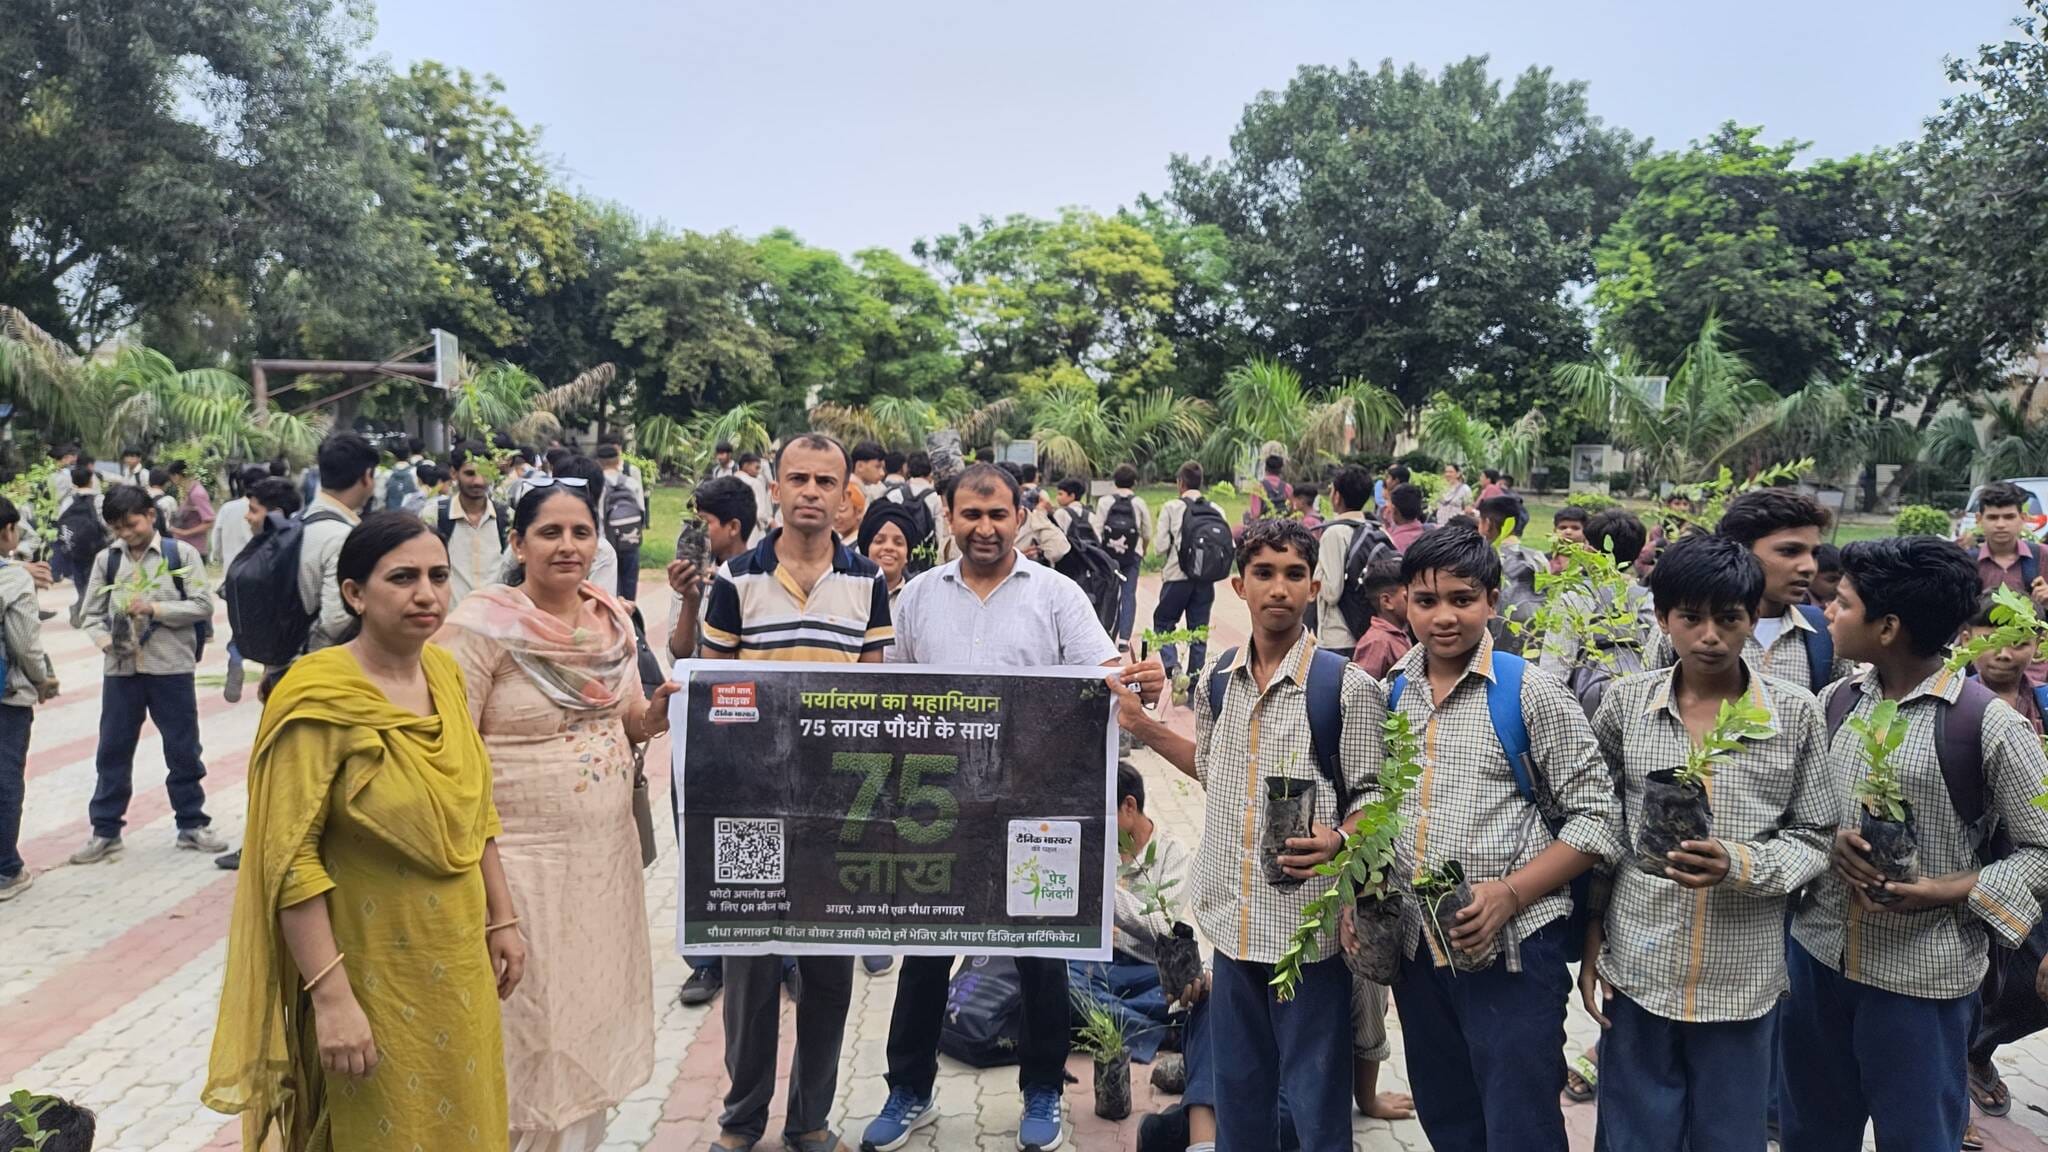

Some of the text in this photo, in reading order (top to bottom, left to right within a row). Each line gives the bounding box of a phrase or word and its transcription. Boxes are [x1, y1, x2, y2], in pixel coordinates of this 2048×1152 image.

[800, 688, 1001, 713] पर्यावरण का महाभियान
[800, 714, 1001, 740] 75 लाख पौधों के साथ
[832, 752, 960, 844] 75
[1016, 833, 1042, 844] दैनिक
[835, 852, 957, 893] लाख
[1049, 869, 1067, 887] पेड़
[709, 886, 786, 899] फोटो अपलोड करने
[706, 901, 791, 913] के लिए QR स्कैन करें
[825, 902, 965, 916] आइए, आप भी एक पौधा लगाइए
[707, 924, 731, 937] पौधा
[733, 927, 771, 937] लगाकर
[772, 926, 783, 936] या
[785, 925, 806, 937] बीज
[808, 926, 835, 938] बोकर
[836, 927, 865, 939] उसकी
[867, 927, 891, 940] फोटो
[893, 927, 907, 941] हमें
[909, 927, 937, 941] भेजिए
[940, 928, 958, 941] और
[961, 931, 985, 942] पाइए
[987, 929, 1025, 942] डिजिटल
